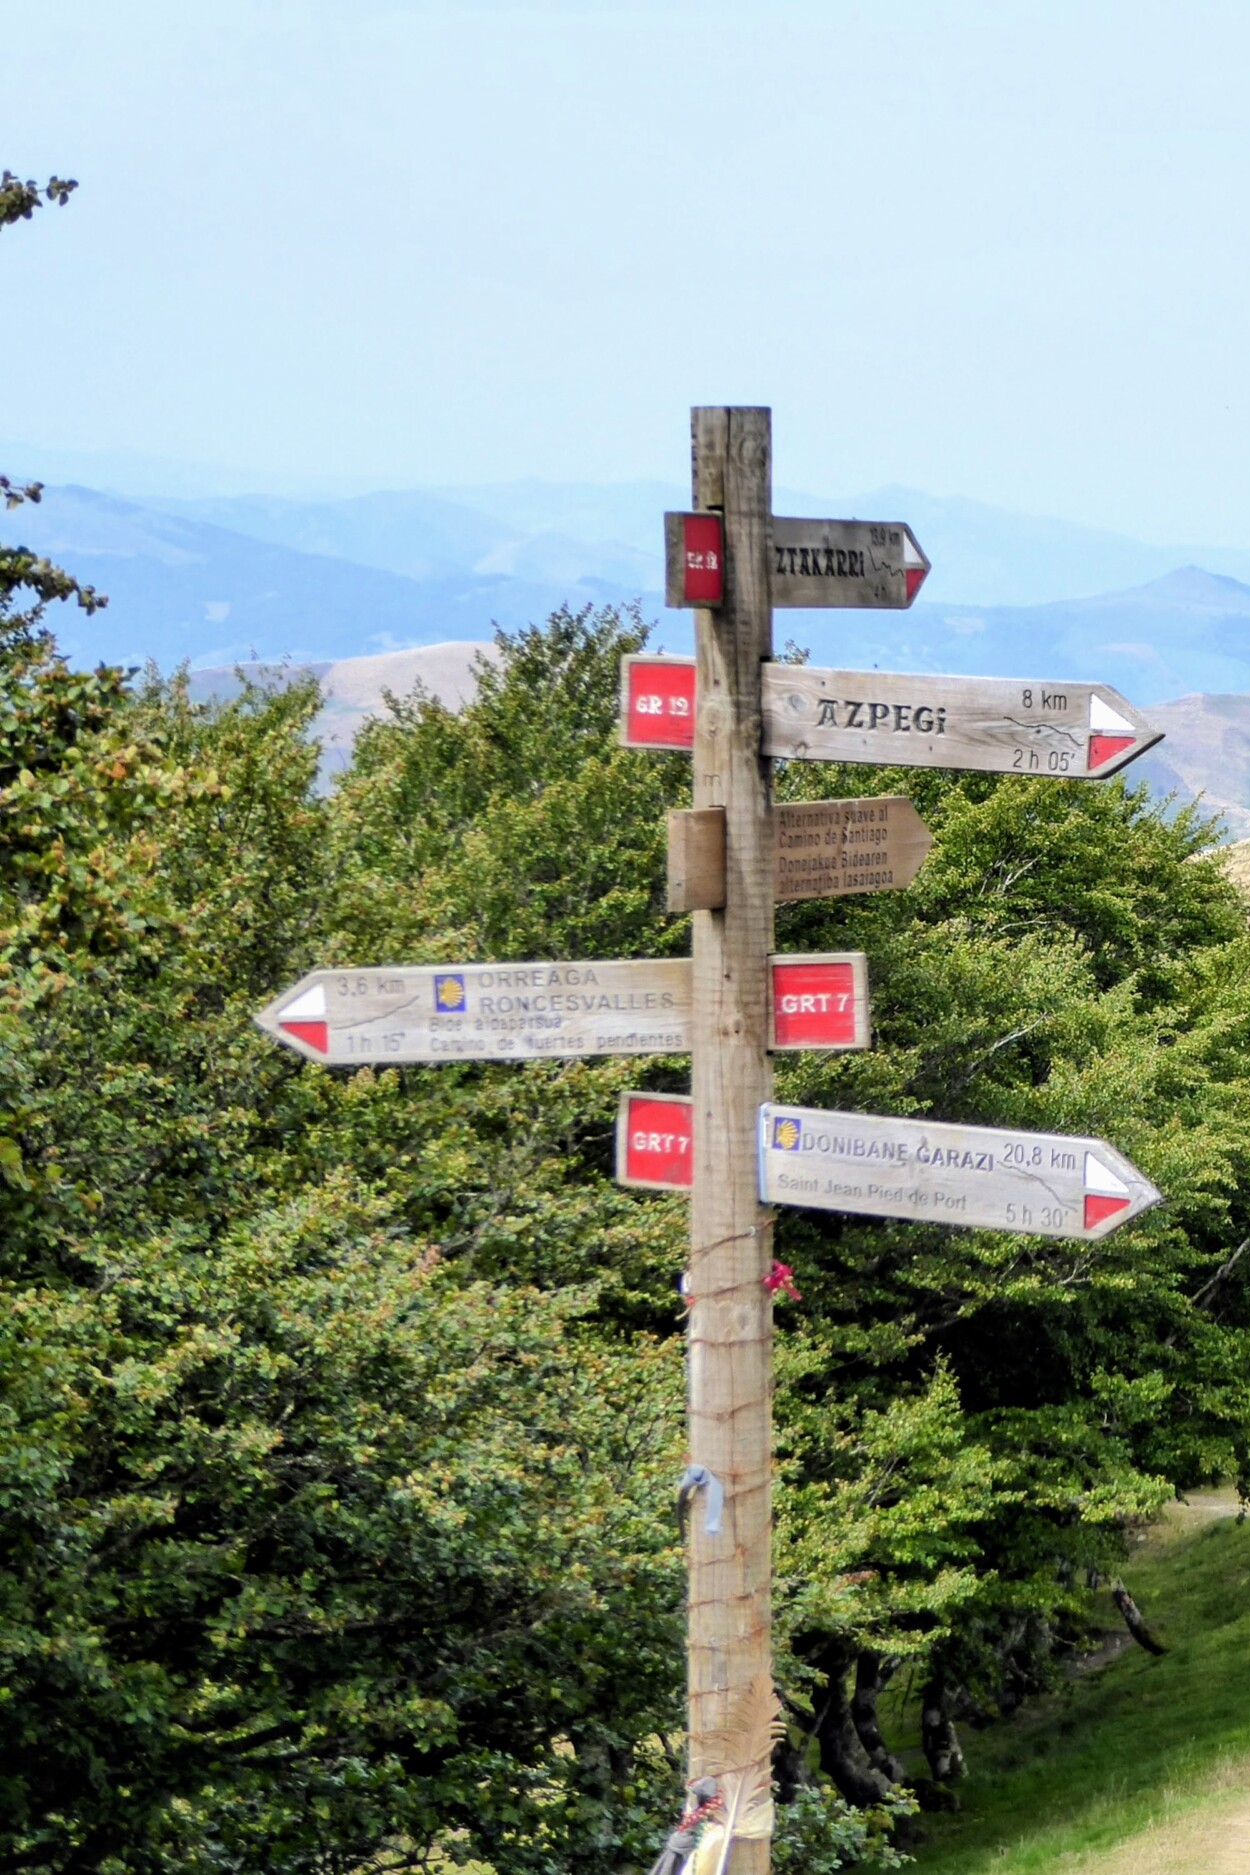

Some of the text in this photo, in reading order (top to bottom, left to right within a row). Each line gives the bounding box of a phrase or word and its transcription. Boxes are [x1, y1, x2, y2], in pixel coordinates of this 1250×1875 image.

[636, 695, 662, 715] GR
[1022, 689, 1068, 711] 8 km
[1013, 748, 1023, 768] 2
[1029, 750, 1039, 770] h
[779, 805, 888, 829] Alternativa suave al
[779, 826, 888, 849] Camino de Santiago
[841, 851, 888, 869] Bidearen
[337, 976, 405, 997] 3,6 km
[478, 968, 599, 988] ORREAGA
[479, 992, 675, 1014] RONCESVALLES
[781, 993, 850, 1014] GRT 7
[347, 1035, 355, 1051] 1
[360, 1034, 372, 1051] h
[429, 1036, 486, 1053] Camino
[499, 1036, 515, 1051] de
[597, 1032, 683, 1051] pendientes
[633, 1131, 690, 1154] GRT 7
[802, 1132, 994, 1172] DONIBANE GARAZI
[1003, 1143, 1076, 1170] 20,8 km
[777, 1173, 967, 1211] Saint Jean Pied de Port
[1006, 1203, 1016, 1223] 5
[1022, 1205, 1033, 1225] h
